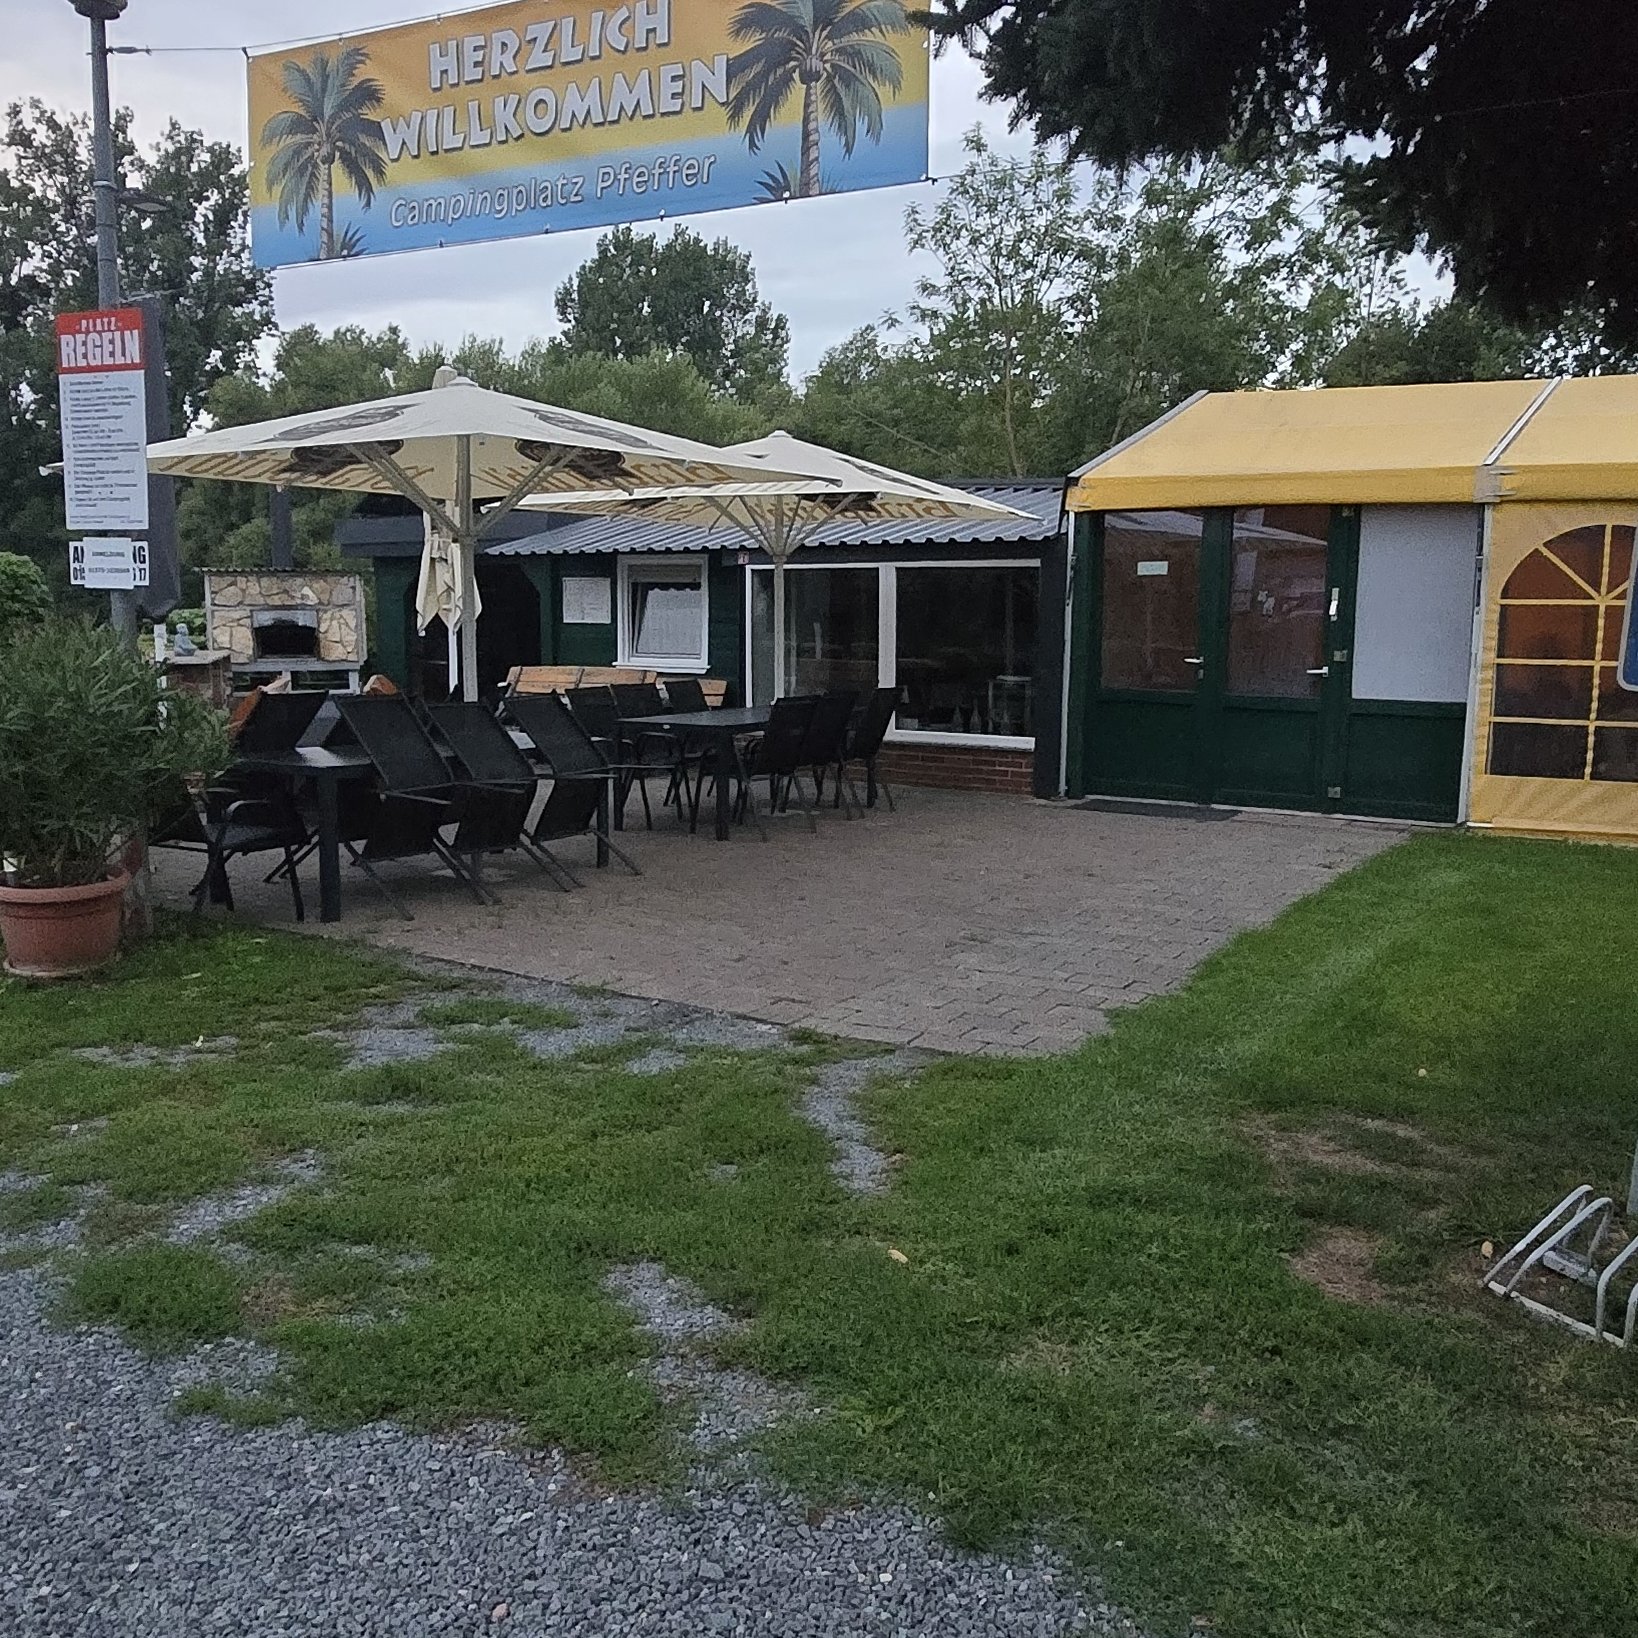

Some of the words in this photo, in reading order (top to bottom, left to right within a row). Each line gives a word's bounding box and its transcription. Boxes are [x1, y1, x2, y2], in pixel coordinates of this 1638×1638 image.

[429, 0, 671, 91] HERZLICH
[381, 54, 729, 161] WILLKOMMEN
[390, 174, 585, 228] Campingplatz
[595, 152, 717, 199] Pfeffer
[59, 329, 141, 368] REGELN
